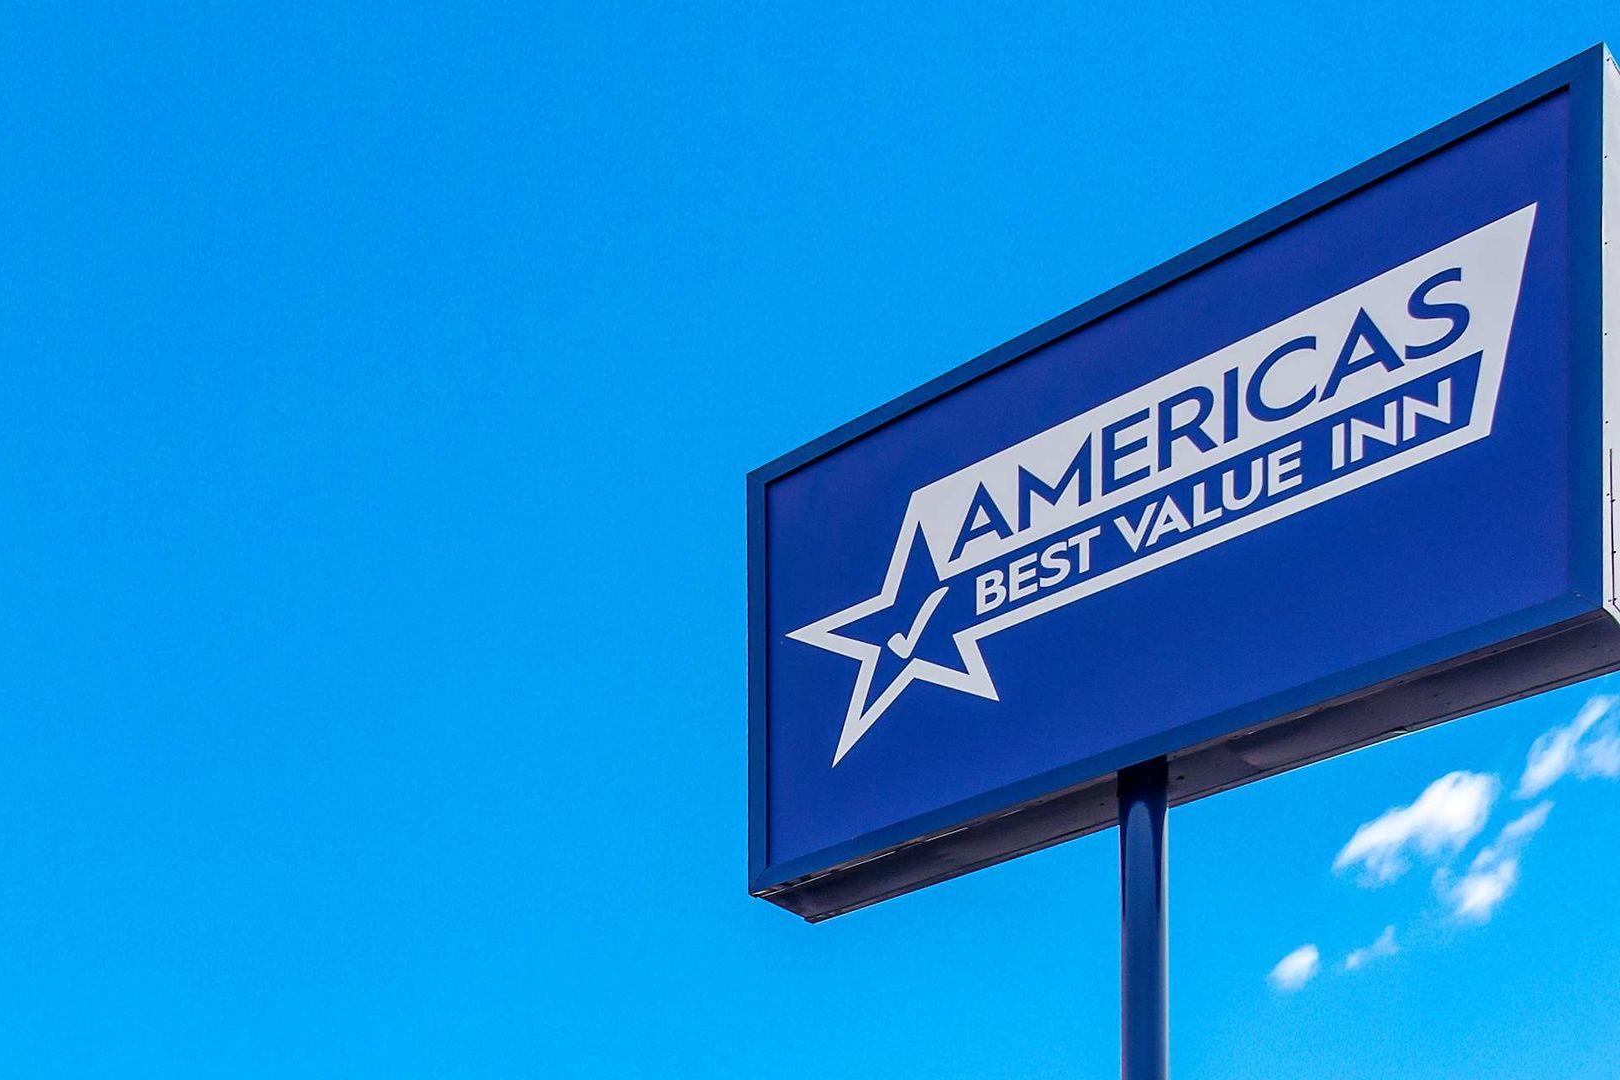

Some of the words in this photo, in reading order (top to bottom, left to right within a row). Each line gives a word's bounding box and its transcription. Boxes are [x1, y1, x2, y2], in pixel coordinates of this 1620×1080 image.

[947, 266, 1471, 564] AMERICAS
[976, 525, 1101, 616] BEST
[1112, 441, 1303, 555] VALUE
[1332, 377, 1451, 470] INN
